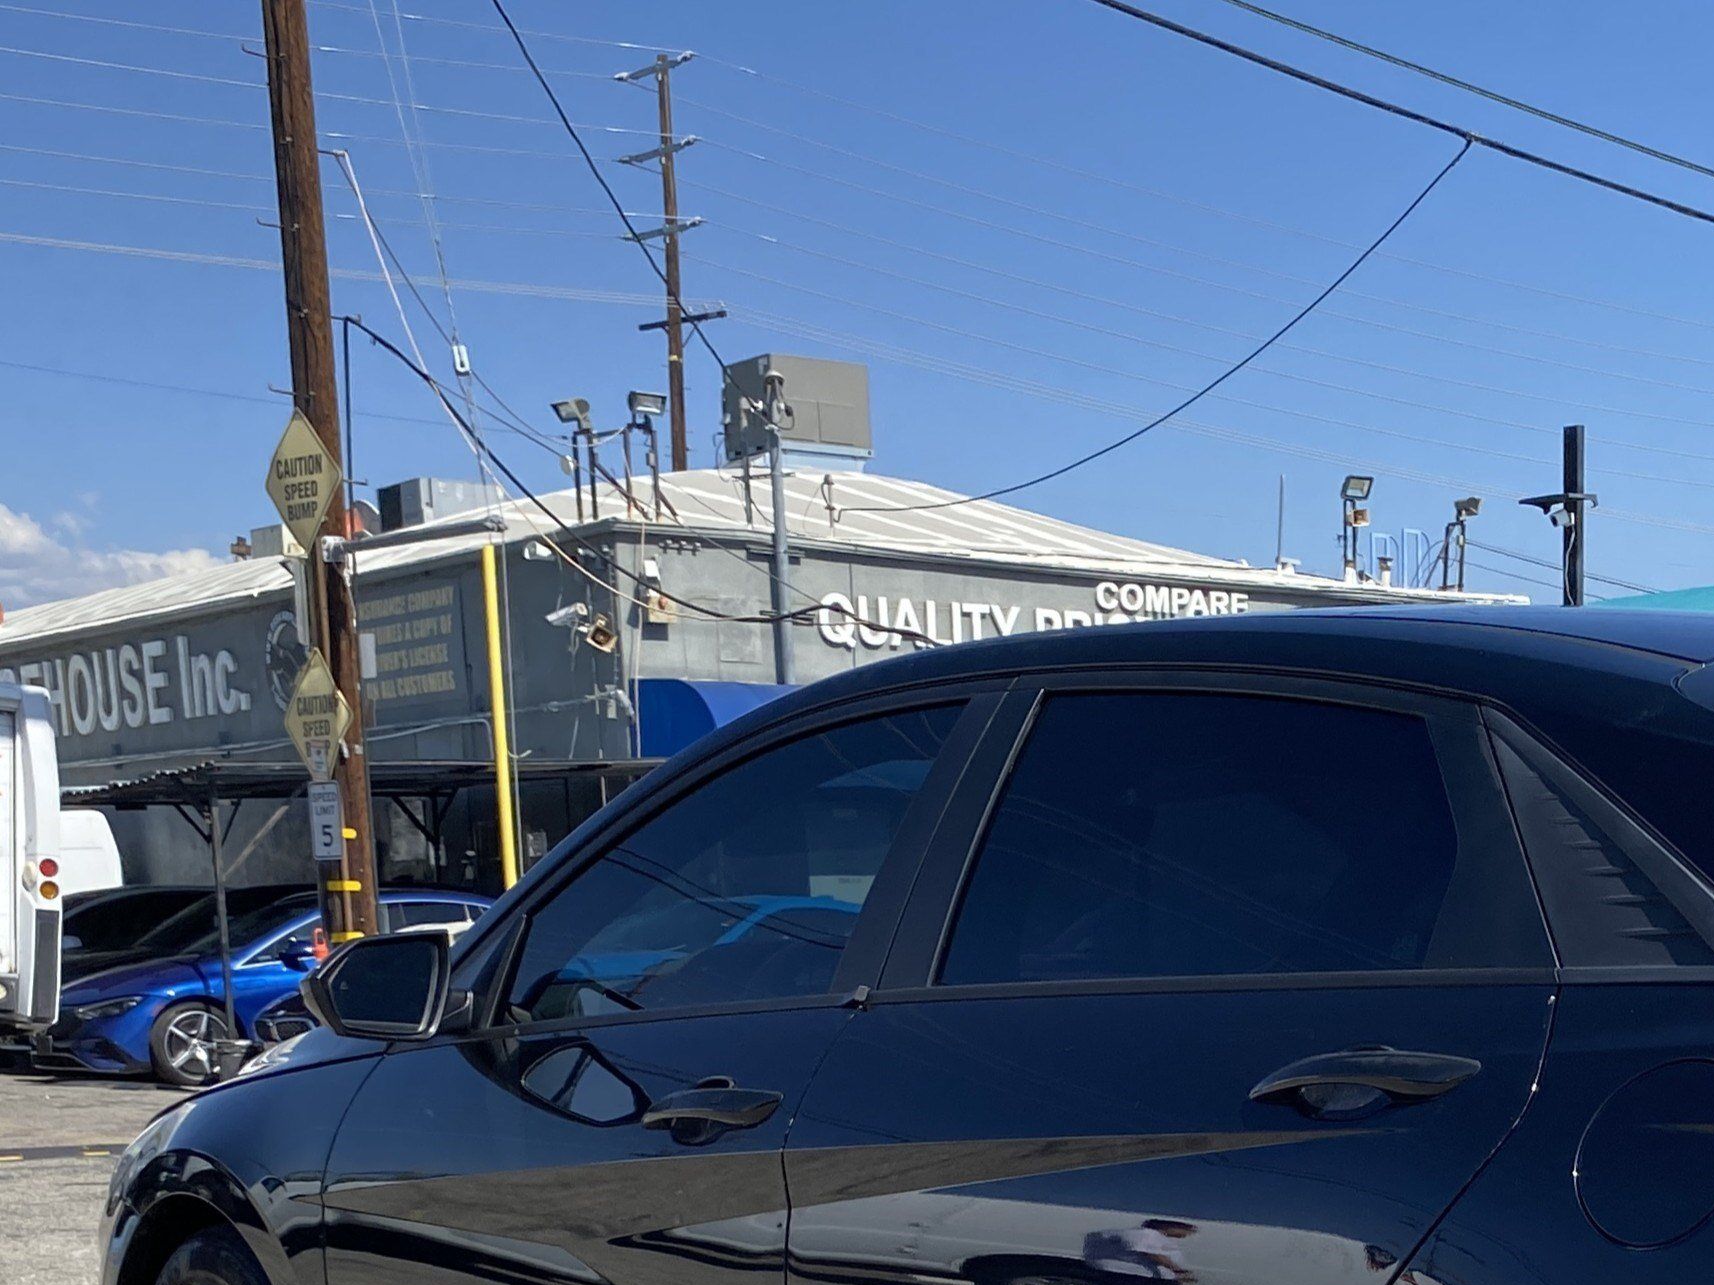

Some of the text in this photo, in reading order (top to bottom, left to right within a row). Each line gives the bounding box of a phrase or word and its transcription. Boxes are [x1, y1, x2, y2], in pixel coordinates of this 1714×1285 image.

[276, 454, 322, 480] CAUTION
[284, 481, 318, 501] SPEED
[287, 501, 318, 521] BUMP
[1095, 581, 1249, 617] COMPARE
[818, 592, 1020, 649] QUALITY
[177, 635, 251, 720] Inc.
[303, 719, 331, 738] SPEED
[312, 791, 337, 803] SPEED
[314, 804, 335, 816] LIMIT
[322, 825, 333, 847] 5
